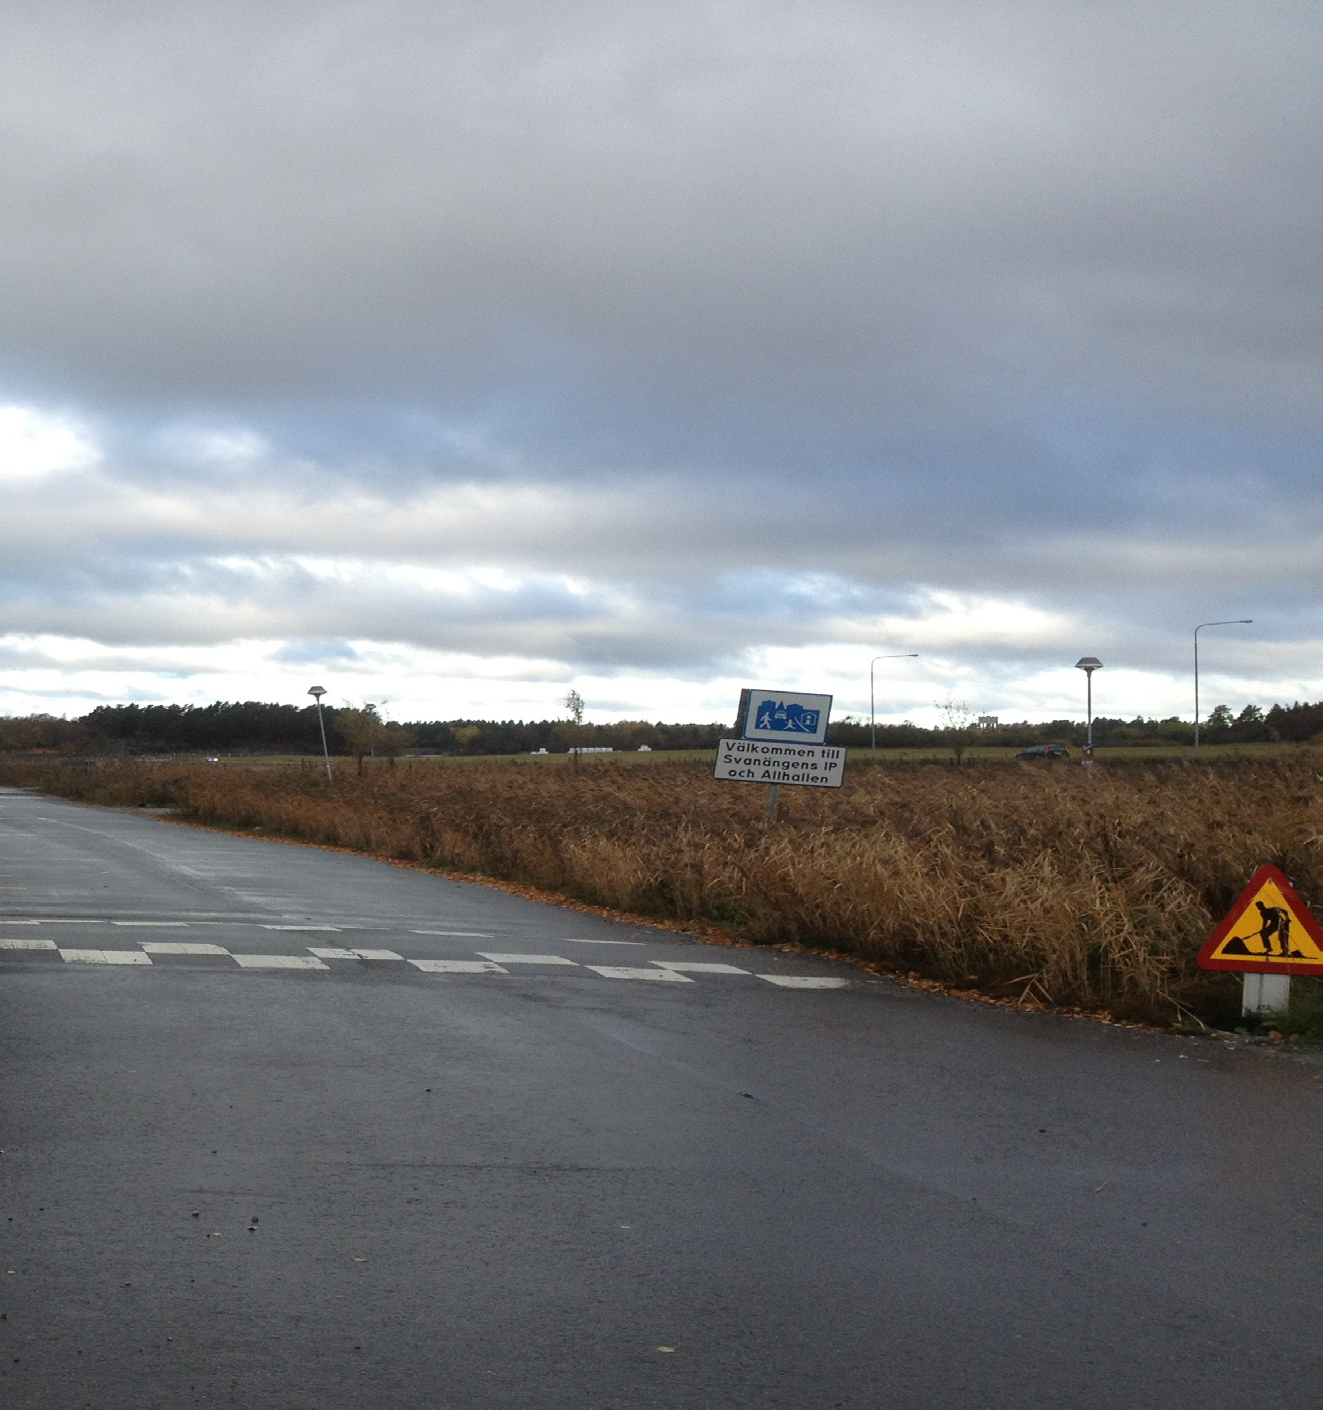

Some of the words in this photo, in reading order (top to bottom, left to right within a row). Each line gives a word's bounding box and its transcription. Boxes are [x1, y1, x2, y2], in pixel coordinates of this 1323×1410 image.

[726, 742, 815, 757] Välkommen
[821, 749, 840, 759] till
[724, 755, 818, 770] Svanängens
[824, 762, 837, 771] IP
[728, 769, 755, 778] och
[761, 770, 828, 783] Allhallen
